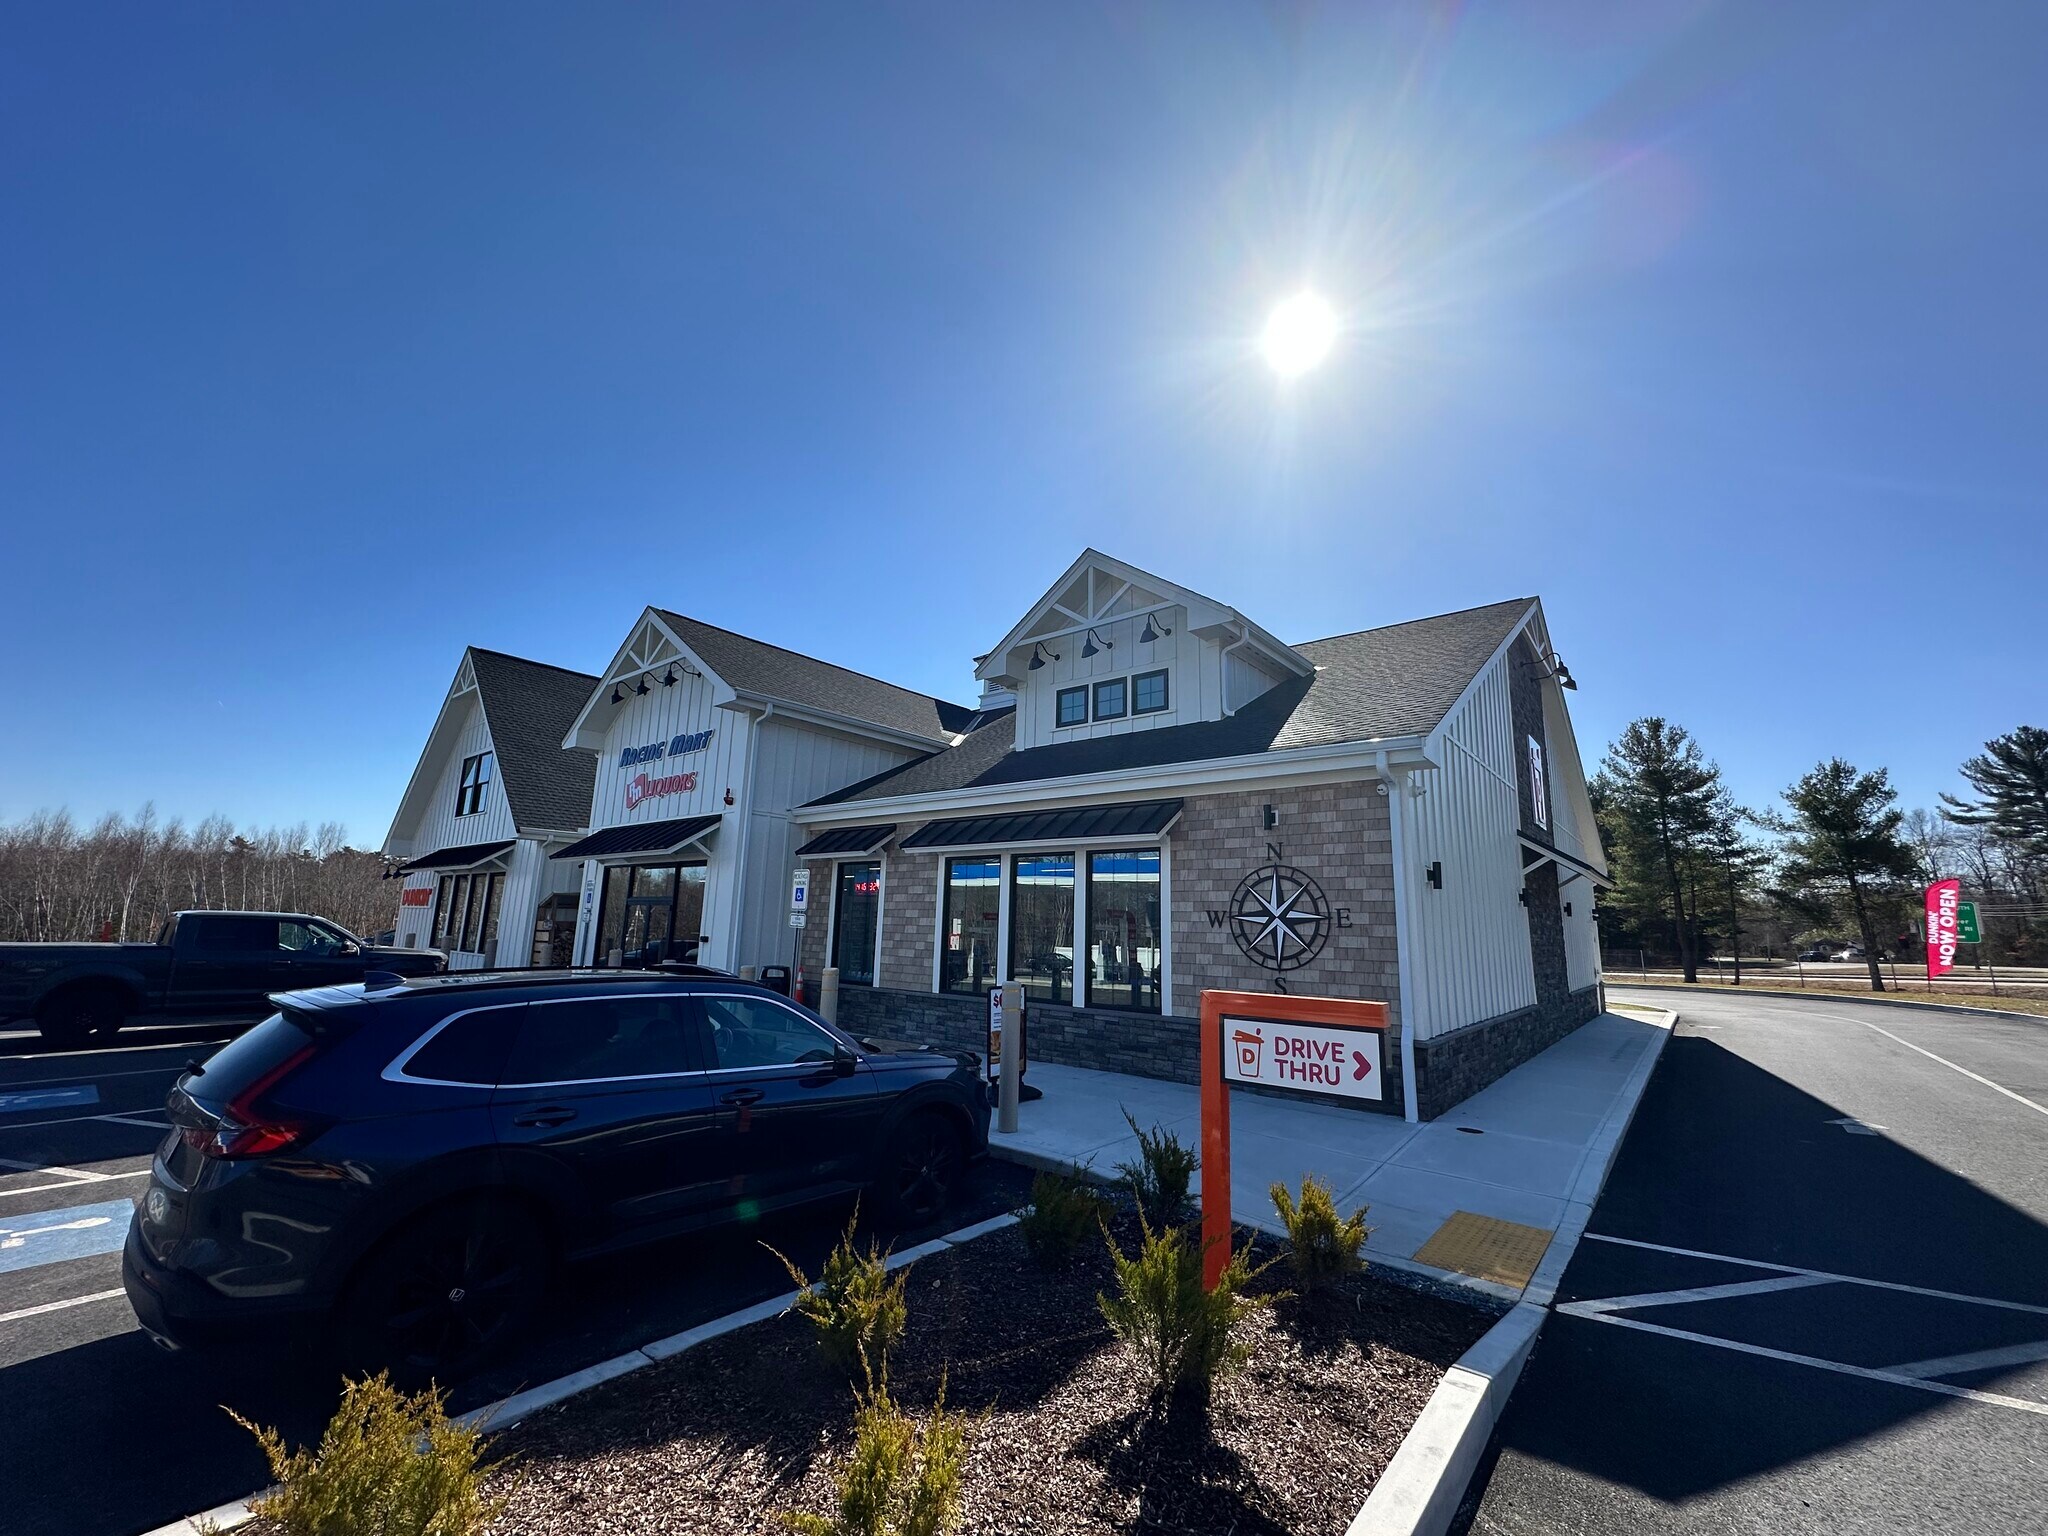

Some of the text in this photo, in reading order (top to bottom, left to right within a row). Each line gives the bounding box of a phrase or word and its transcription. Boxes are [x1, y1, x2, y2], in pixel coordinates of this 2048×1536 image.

[619, 730, 713, 768] RACING MART
[645, 771, 698, 798] LIQUORS
[1265, 842, 1284, 861] N
[1205, 910, 1227, 928] W
[1335, 908, 1353, 928] E
[1940, 889, 1956, 966] NOW OPEN
[1274, 976, 1288, 995] S
[1242, 1048, 1255, 1064] D
[1274, 1036, 1345, 1063] DRIVE
[1274, 1058, 1341, 1086] THRU
